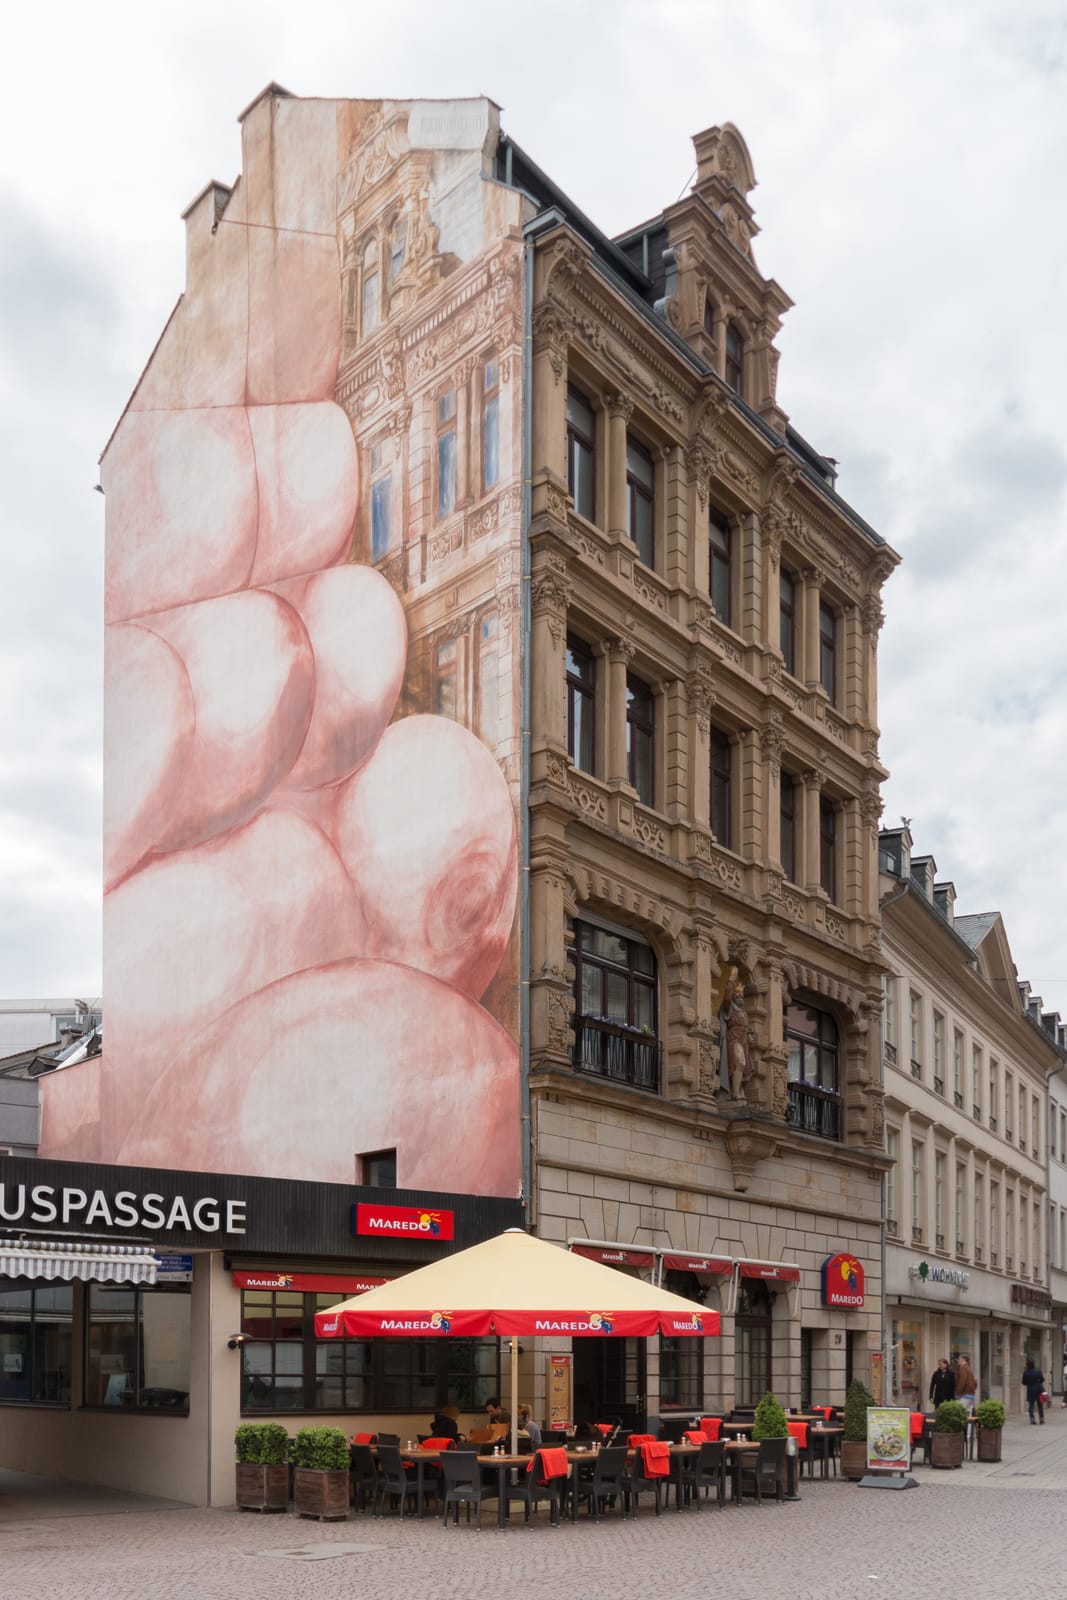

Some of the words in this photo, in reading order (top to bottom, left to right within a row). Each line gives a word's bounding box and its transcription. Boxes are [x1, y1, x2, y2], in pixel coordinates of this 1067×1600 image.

[369, 1218, 431, 1232] MAREDO
[247, 1279, 286, 1287] MAREDO
[831, 1293, 863, 1305] MAREDO
[381, 1319, 441, 1330] MAREDO
[535, 1320, 602, 1331] MAREDO
[673, 1320, 698, 1330] MAREDO
